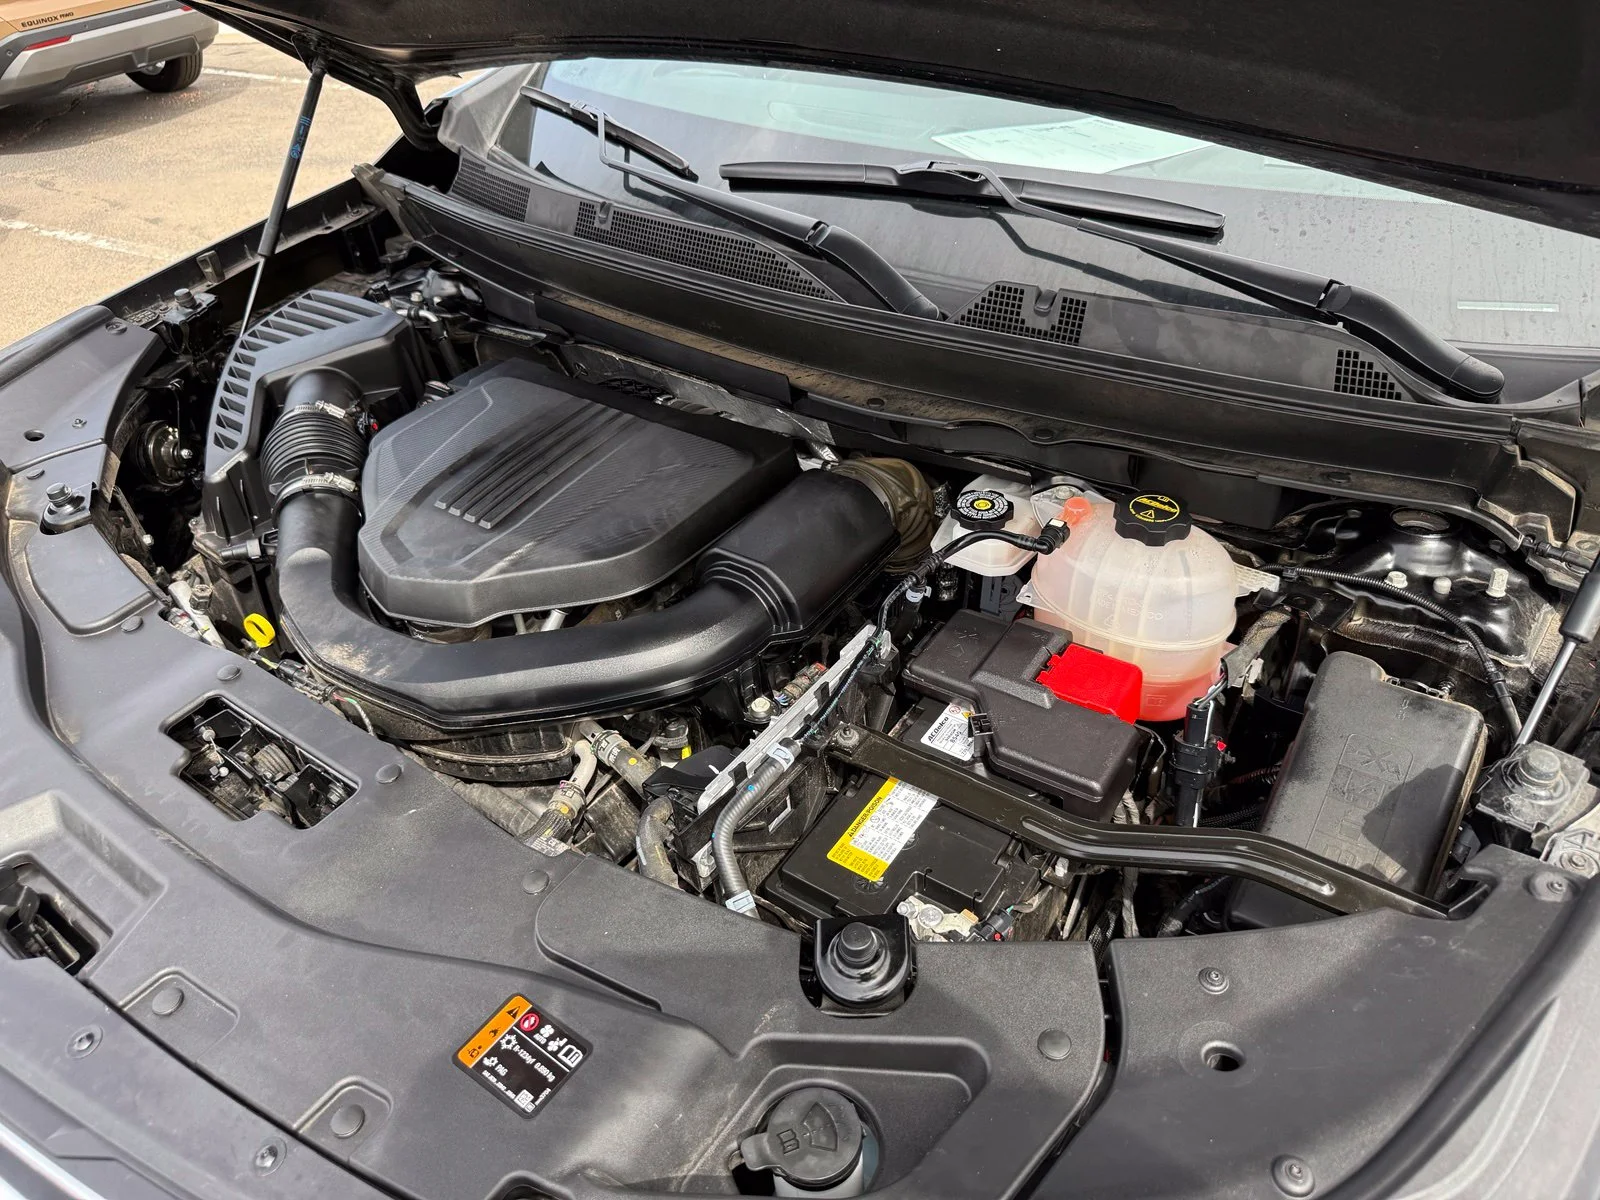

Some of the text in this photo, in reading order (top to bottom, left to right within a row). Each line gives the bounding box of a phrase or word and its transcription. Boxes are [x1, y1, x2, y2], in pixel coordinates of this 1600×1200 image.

[21, 15, 59, 28] EQUINOX
[927, 716, 949, 742] ACDelco
[494, 1063, 508, 1077] PAG
